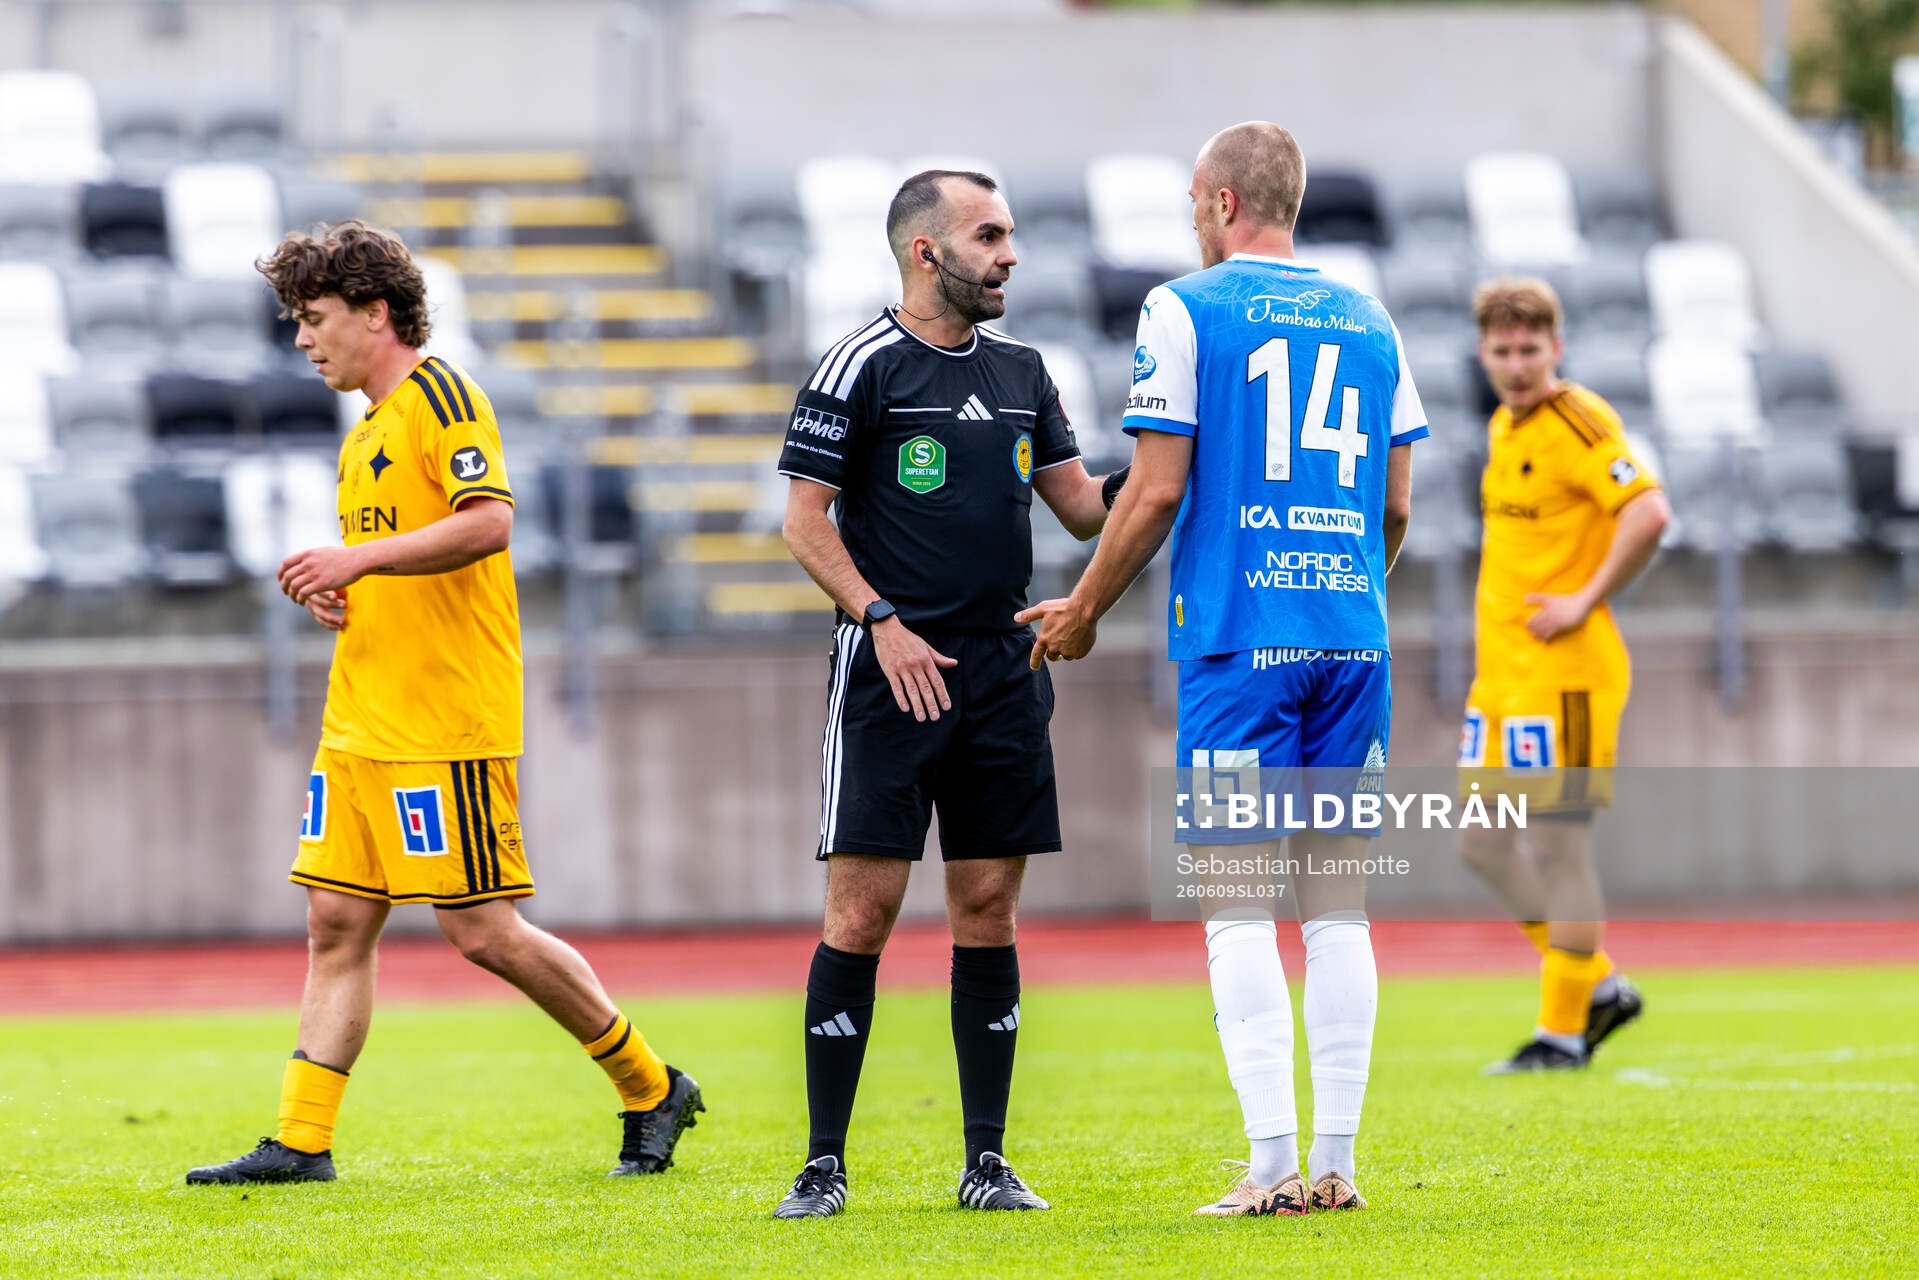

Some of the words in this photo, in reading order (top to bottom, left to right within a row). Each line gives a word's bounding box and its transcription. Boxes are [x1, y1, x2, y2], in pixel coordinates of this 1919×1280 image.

[1246, 336, 1369, 489] 14
[791, 416, 845, 442] KPMG
[914, 443, 931, 464] S
[905, 467, 939, 476] SUPERETTAN
[1239, 505, 1282, 529] ICA
[1294, 510, 1362, 531] KVANTUM
[1266, 550, 1353, 572] NORDIC
[1245, 570, 1369, 593] WELLNESS
